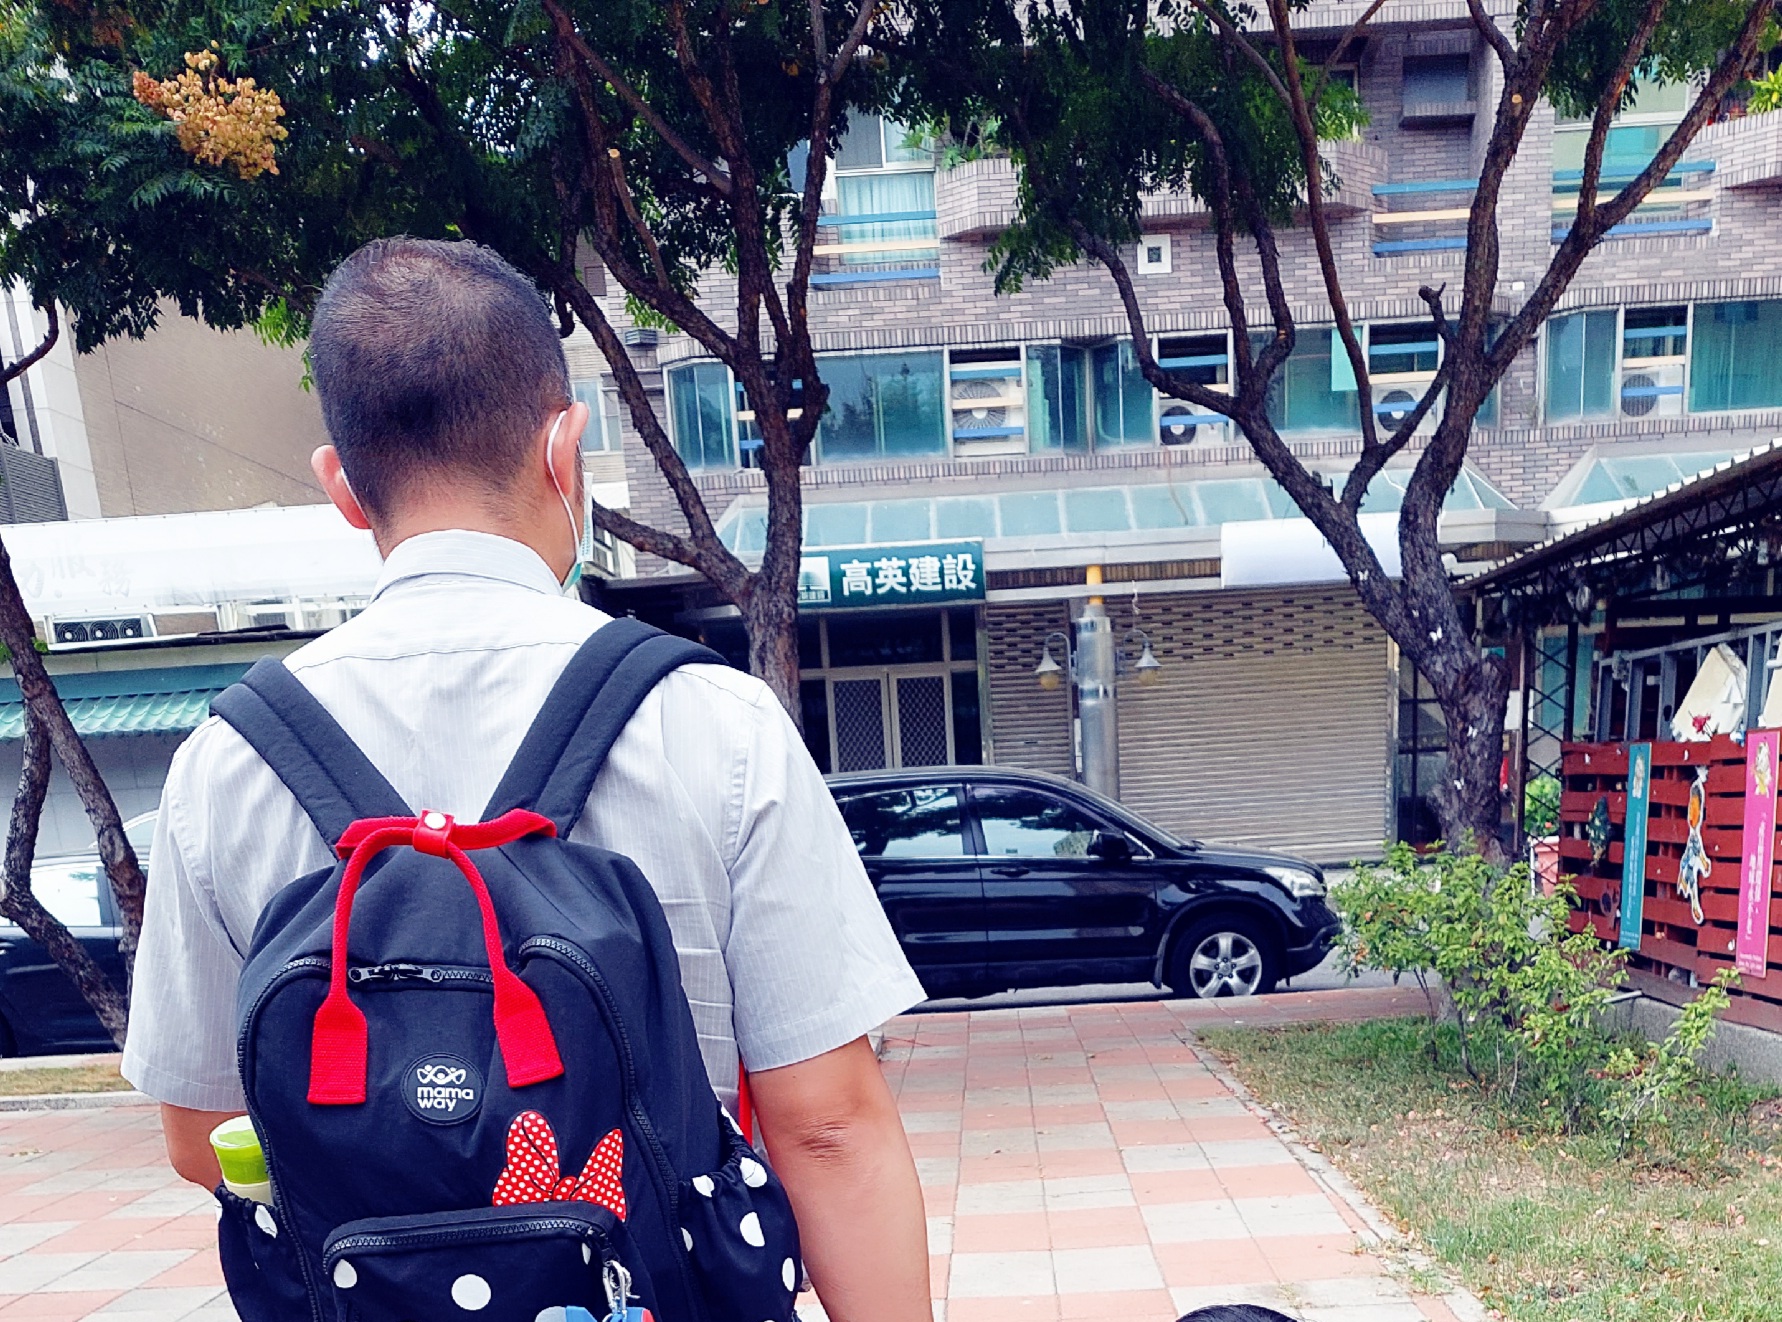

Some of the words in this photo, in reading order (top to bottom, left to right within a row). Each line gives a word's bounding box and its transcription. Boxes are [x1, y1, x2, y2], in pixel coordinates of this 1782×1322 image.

[840, 553, 976, 596] 高英建設
[417, 1086, 474, 1100] mama
[417, 1098, 457, 1111] way
